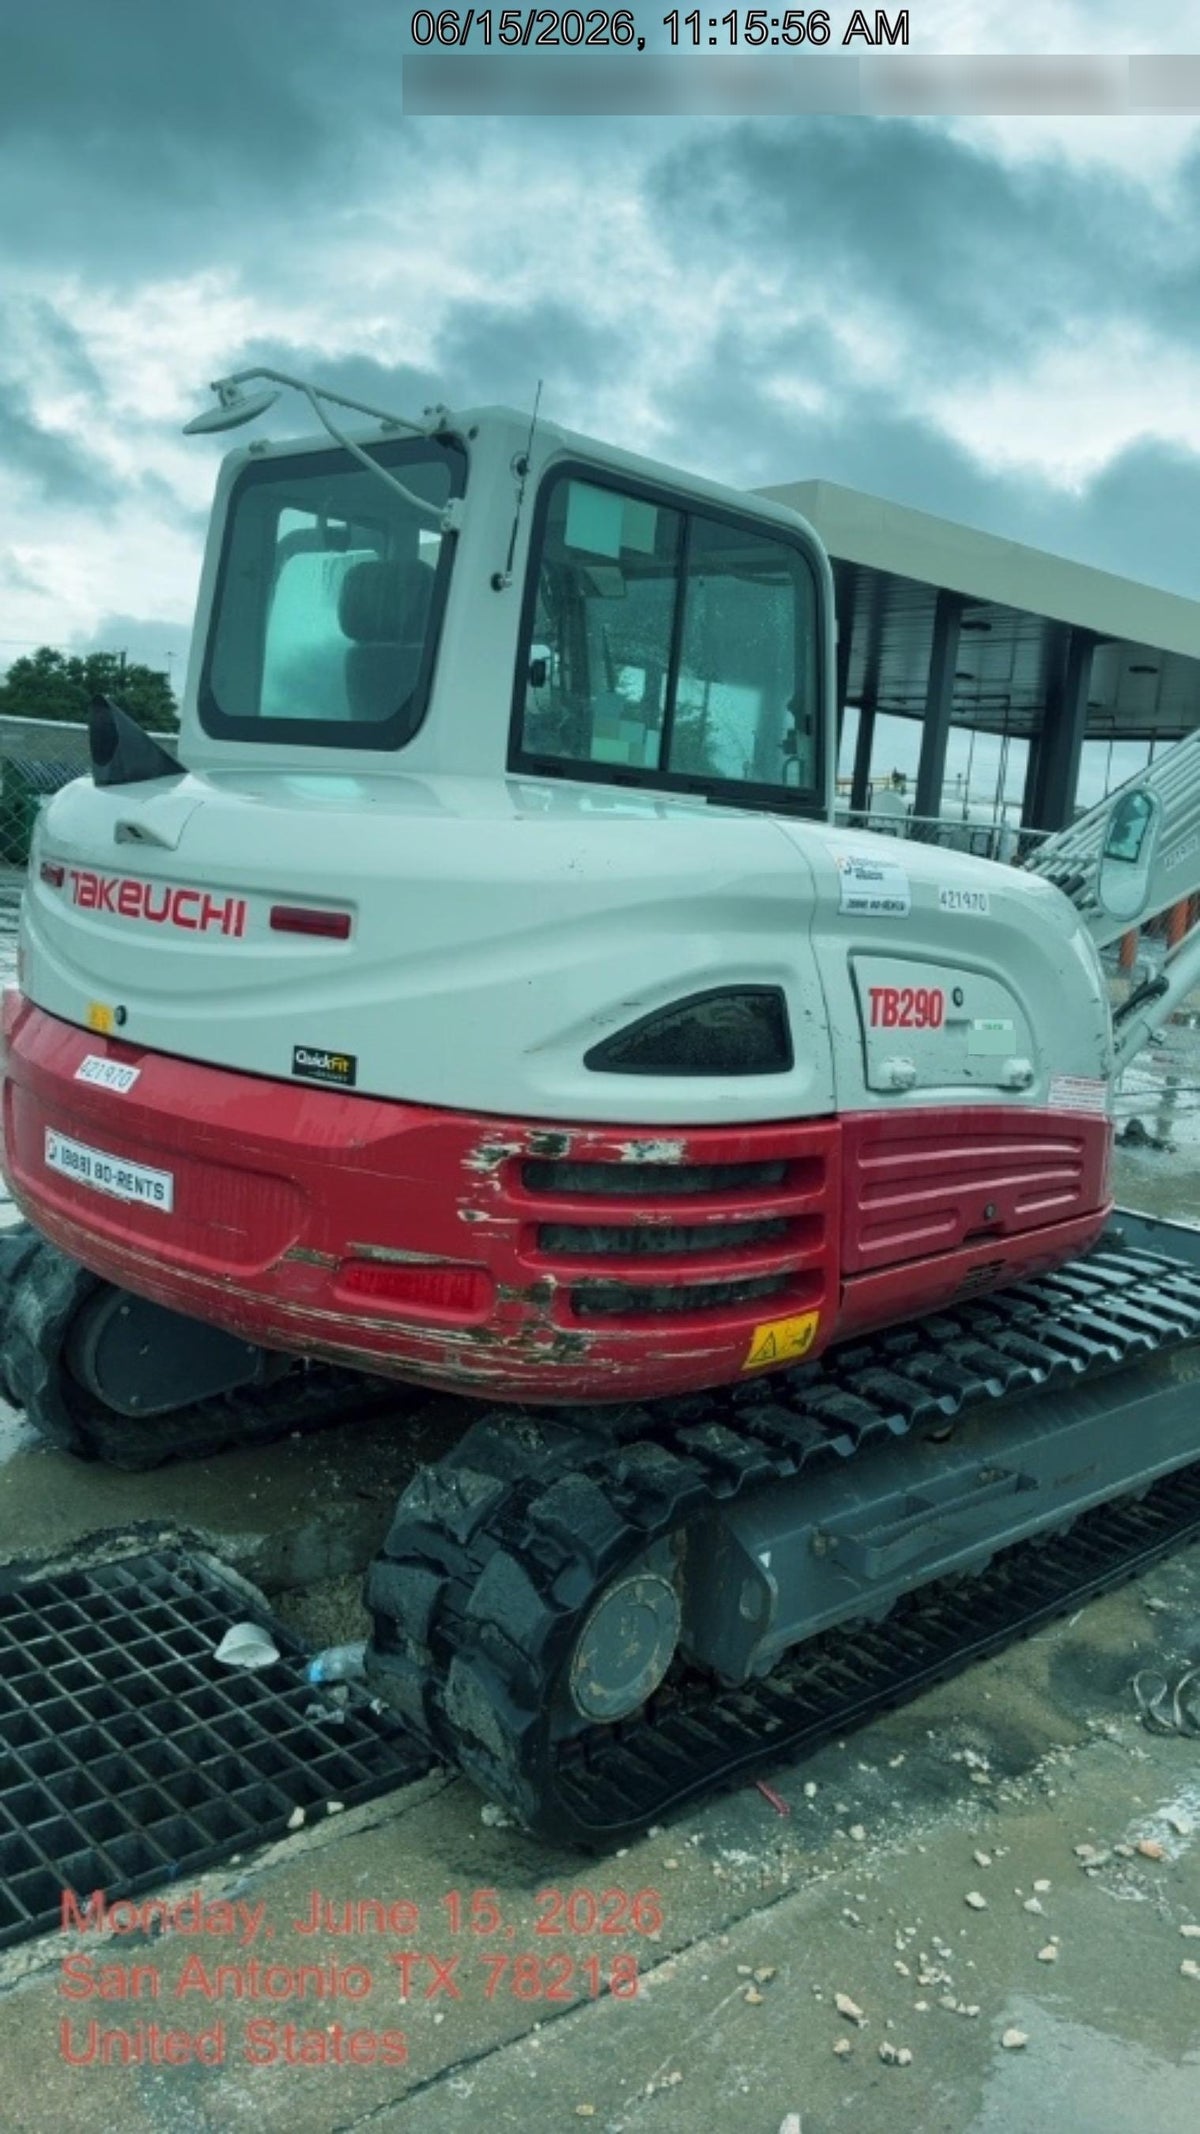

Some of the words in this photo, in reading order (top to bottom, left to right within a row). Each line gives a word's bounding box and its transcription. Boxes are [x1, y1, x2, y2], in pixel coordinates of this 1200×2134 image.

[939, 889, 988, 912] 421970
[868, 987, 944, 1028] TB290
[94, 1161, 165, 1201] 80-RENTS
